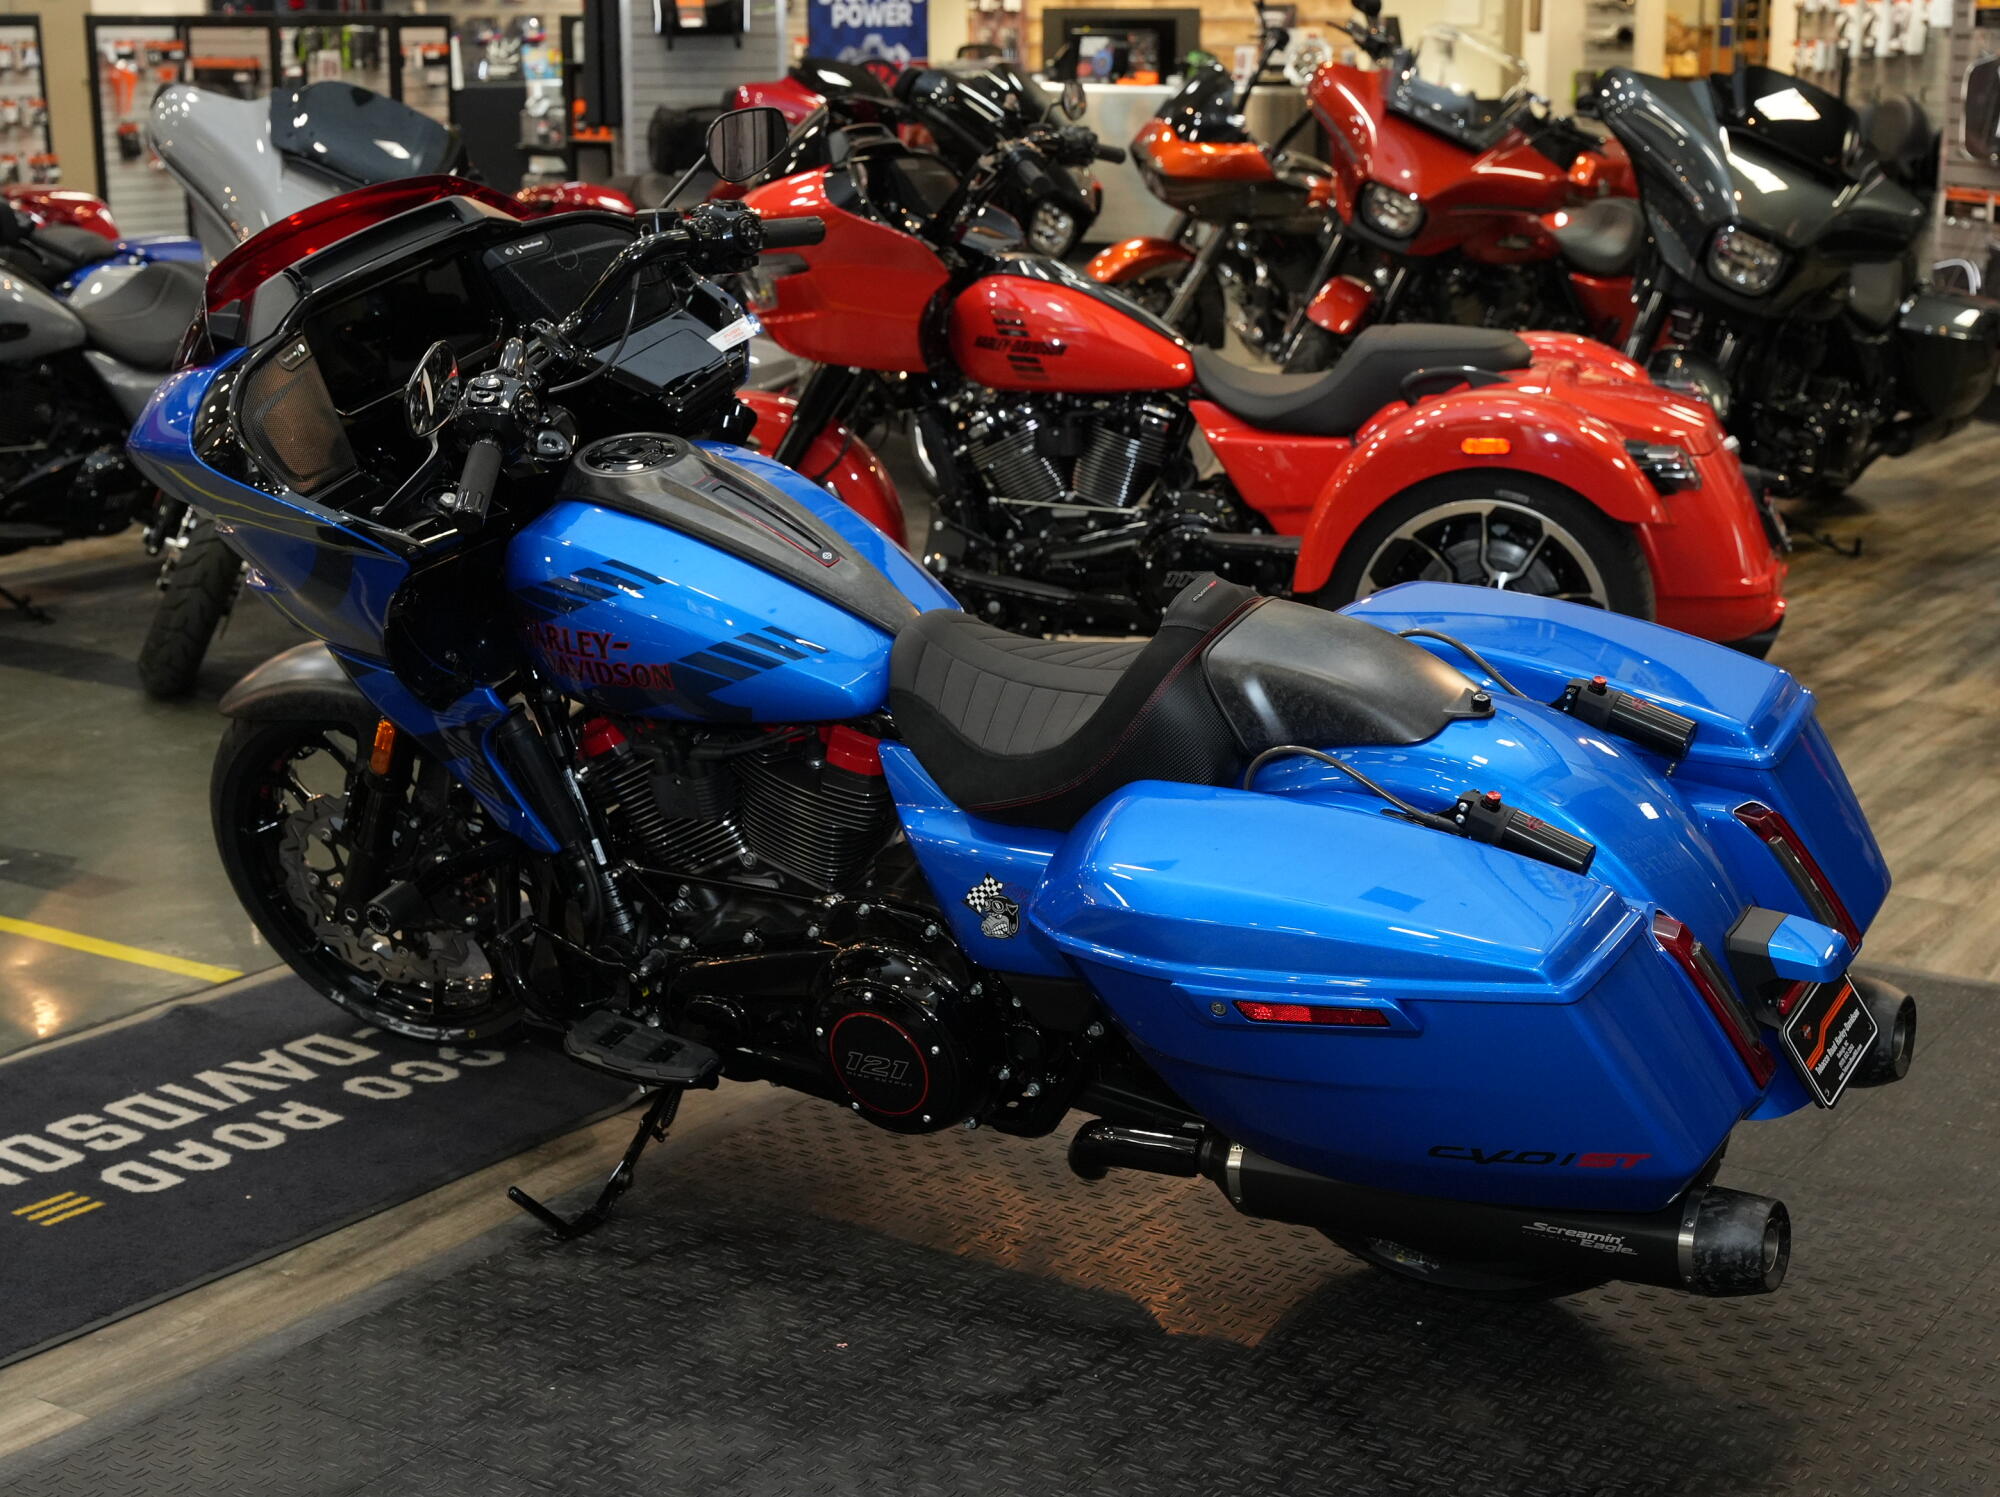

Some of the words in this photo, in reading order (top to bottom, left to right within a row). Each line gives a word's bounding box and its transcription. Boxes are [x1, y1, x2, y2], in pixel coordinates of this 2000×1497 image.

[831, 2, 913, 29] POWER
[846, 1051, 909, 1080] 121
[100, 1101, 344, 1194] ROAD
[1521, 1221, 1626, 1244] Screamin'
[1580, 1238, 1639, 1255] Eagle
